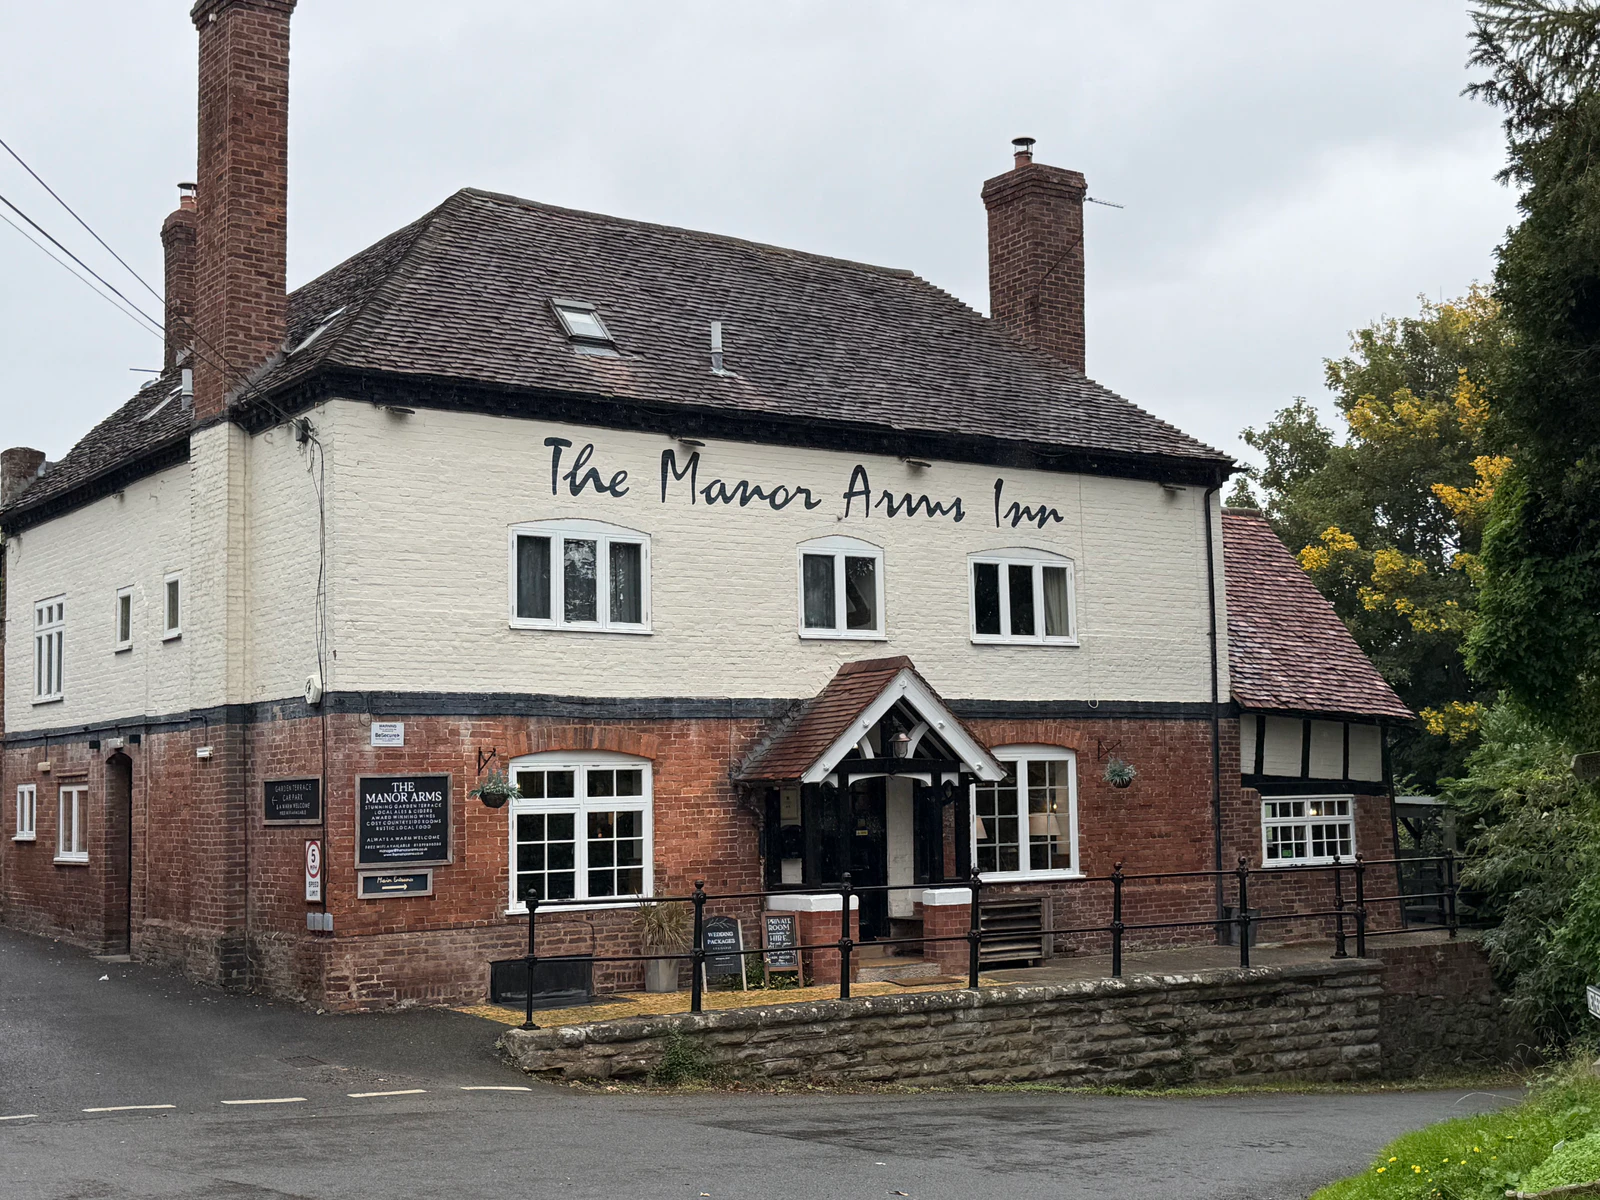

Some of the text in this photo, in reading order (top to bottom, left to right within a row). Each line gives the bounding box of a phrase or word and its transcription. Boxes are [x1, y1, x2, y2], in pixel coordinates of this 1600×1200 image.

[543, 437, 1064, 529] The Manor Arms Inn
[391, 781, 415, 792] THE
[365, 791, 442, 804] MANOR ARMS
[311, 848, 316, 863] 5
[376, 876, 393, 884] Main
[767, 917, 792, 925] PRIVATE
